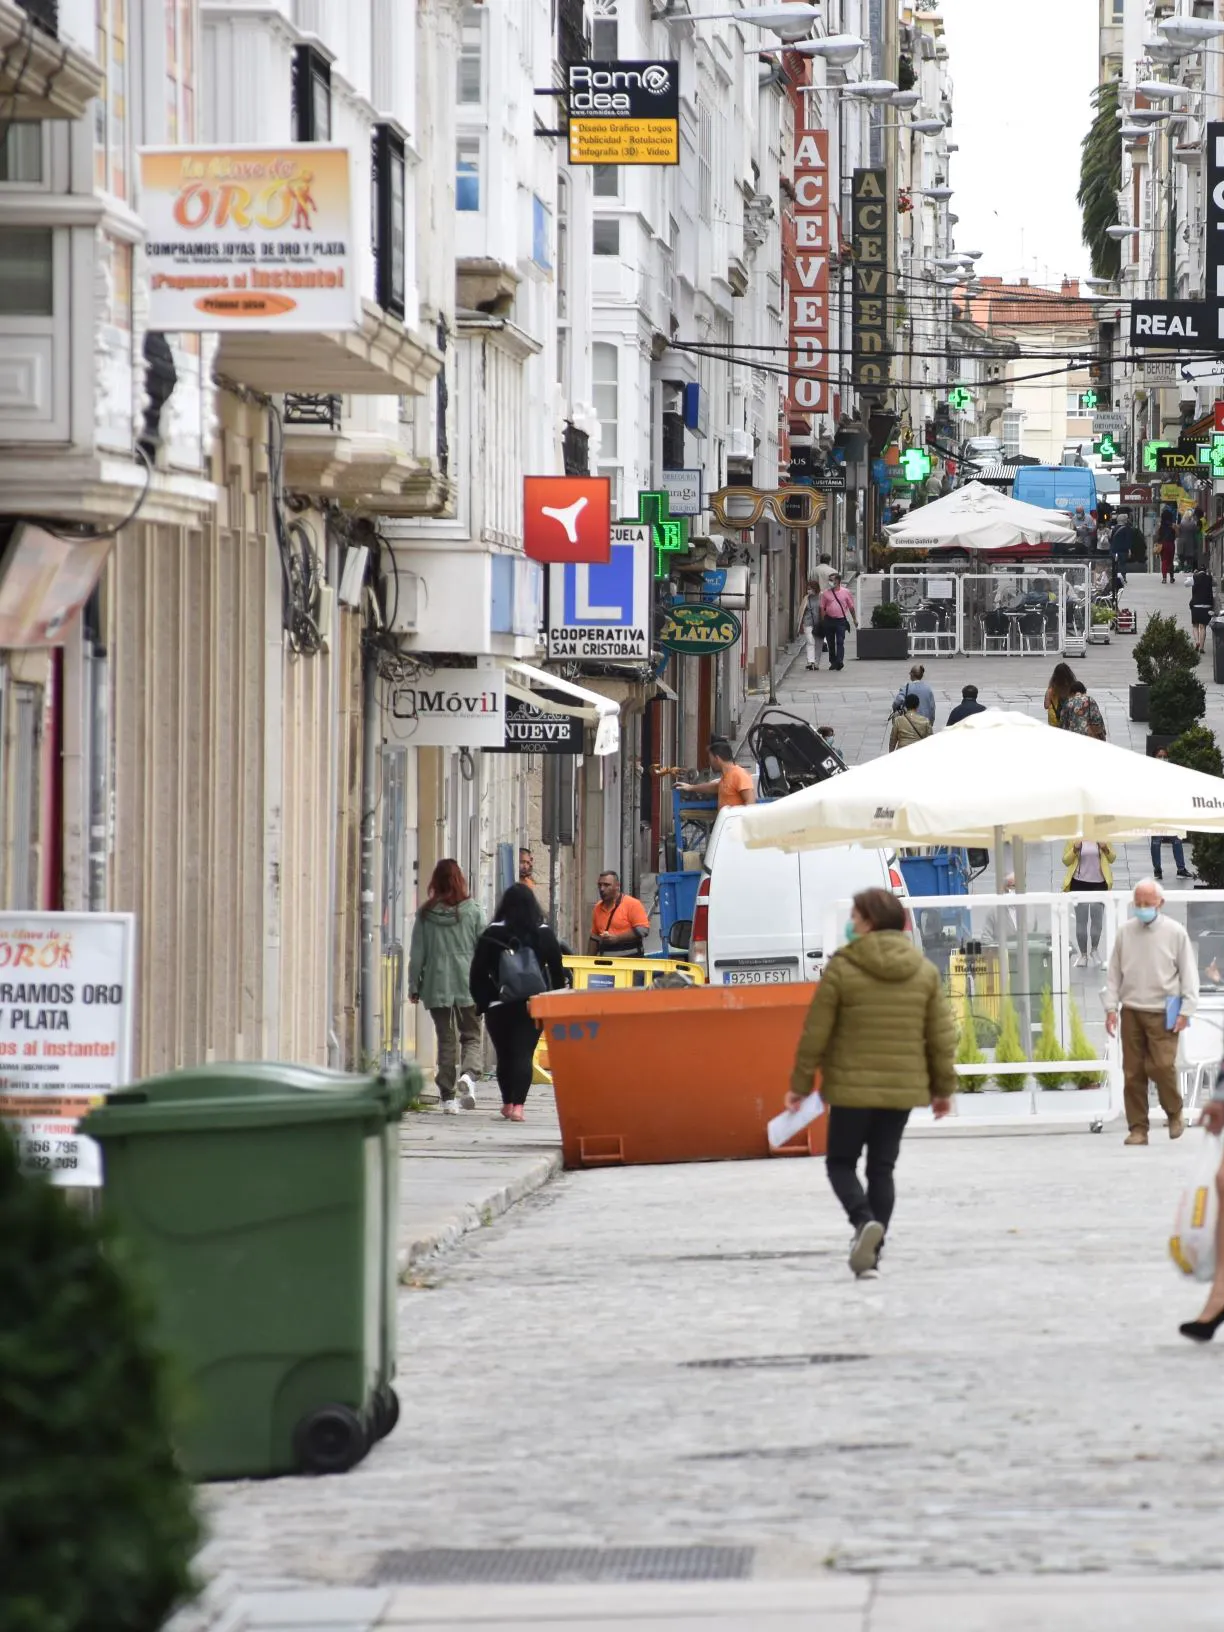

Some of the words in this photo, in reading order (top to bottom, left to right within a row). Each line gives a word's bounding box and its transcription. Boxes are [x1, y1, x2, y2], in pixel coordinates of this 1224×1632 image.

[569, 88, 630, 109] idea
[647, 124, 672, 134] Logos
[578, 135, 621, 144] Publicidad
[172, 179, 294, 231] ORO
[145, 242, 219, 257] COMPRAMOS
[261, 242, 275, 256] DE
[279, 242, 300, 256] ORO
[304, 242, 312, 256] Y
[313, 242, 347, 256] PLATA
[794, 135, 826, 408] ACEVEDO
[856, 172, 885, 388] ACEVEDO
[1135, 314, 1199, 337] REAL
[550, 628, 645, 641] COOPERATIVA
[660, 623, 735, 642] PLATAS
[552, 643, 577, 655] SAN
[582, 643, 643, 656] CRISTOBAL
[417, 690, 499, 713] Móvil
[504, 722, 571, 740] NUEVE
[520, 743, 548, 752] MODA
[731, 972, 761, 985] 9250
[764, 970, 787, 983] FSY
[82, 982, 123, 1005] ORO
[10, 1008, 70, 1031] PLATA
